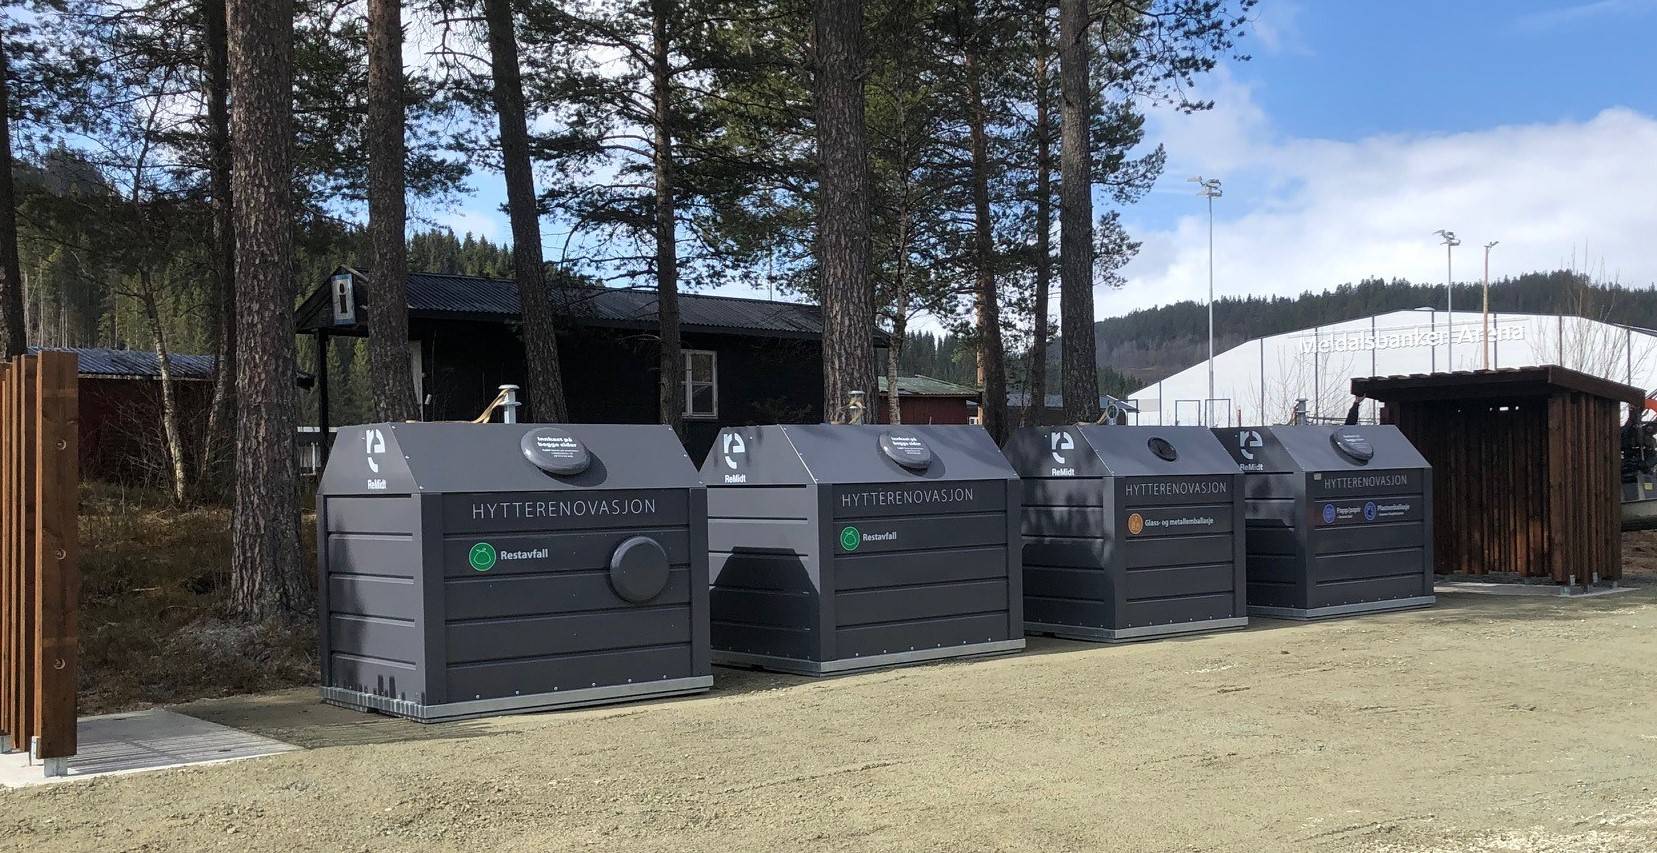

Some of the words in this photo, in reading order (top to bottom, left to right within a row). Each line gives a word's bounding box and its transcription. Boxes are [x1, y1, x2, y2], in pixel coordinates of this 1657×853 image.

[1051, 468, 1075, 476] ReMidt
[1240, 463, 1264, 471] ReMidt
[725, 474, 746, 483] ReMidt
[1324, 474, 1407, 489] HYTTERENOVASJON
[1125, 482, 1227, 496] HYTTERENOVASJON
[842, 488, 974, 507] HYTTERENOVASJON
[472, 499, 656, 519] HYTTERENOVASJON
[1161, 519, 1169, 527] og
[862, 532, 897, 542] Restavfall
[500, 549, 549, 560] Restavfall
